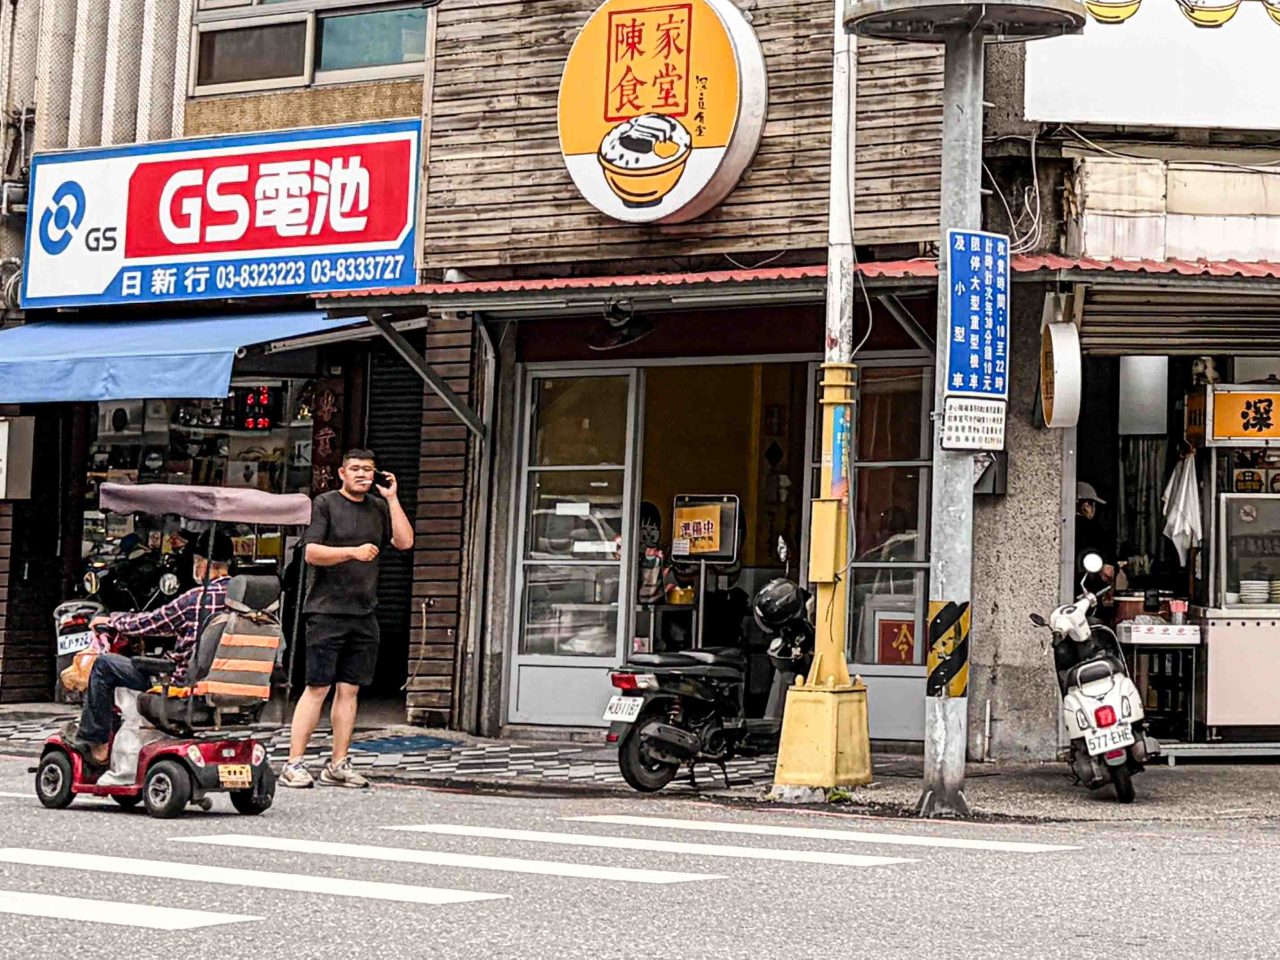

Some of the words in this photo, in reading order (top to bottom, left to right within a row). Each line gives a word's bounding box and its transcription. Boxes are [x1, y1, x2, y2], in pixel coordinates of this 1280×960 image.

[615, 13, 685, 63] 陳家
[610, 62, 683, 113] 食堂
[158, 155, 370, 245] GS電池
[85, 226, 118, 252] GS
[121, 266, 210, 297] 日新行
[216, 260, 305, 289] 03-8323223
[311, 254, 404, 283] 03-8333727
[1088, 728, 1131, 750] 577-EHE
